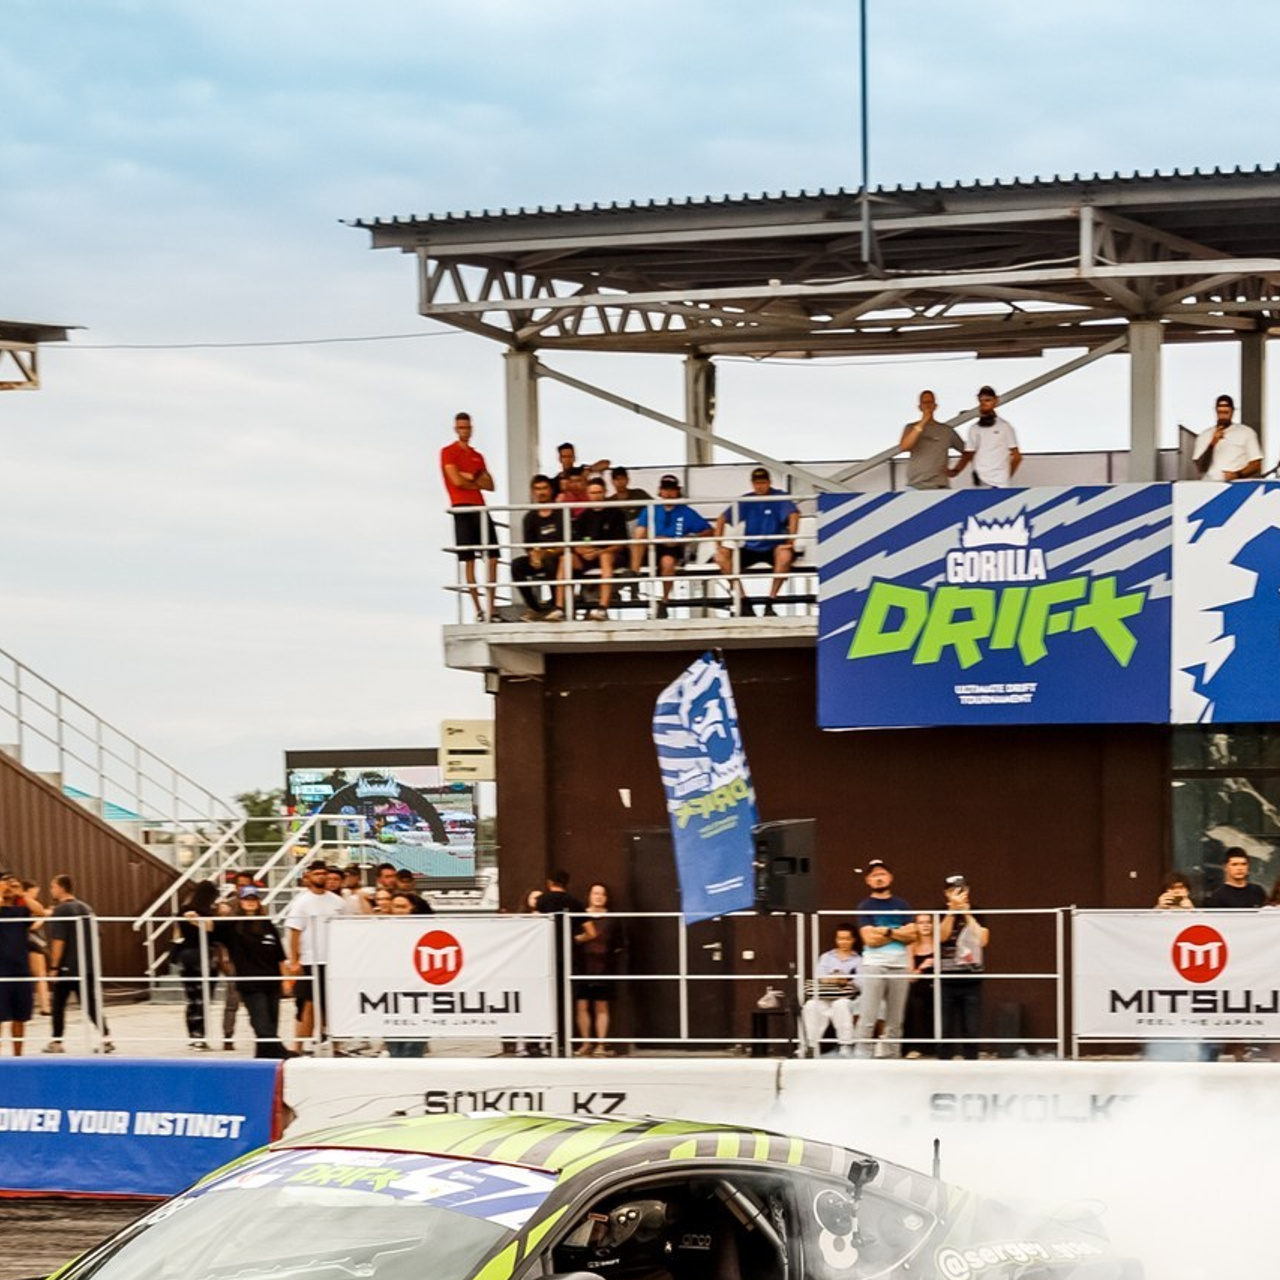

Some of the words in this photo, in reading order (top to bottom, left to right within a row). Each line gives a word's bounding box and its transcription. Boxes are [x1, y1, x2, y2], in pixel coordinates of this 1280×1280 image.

[946, 548, 1047, 584] GORILLA
[846, 575, 1147, 670] DRIFT
[359, 991, 520, 1014] MITSUJI
[1136, 1018, 1174, 1026] FEEL
[1213, 1018, 1265, 1026] JAPAN
[66, 1110, 130, 1135] YOUR
[133, 1111, 246, 1139] INSTINCT
[293, 1164, 399, 1192] DRIFT
